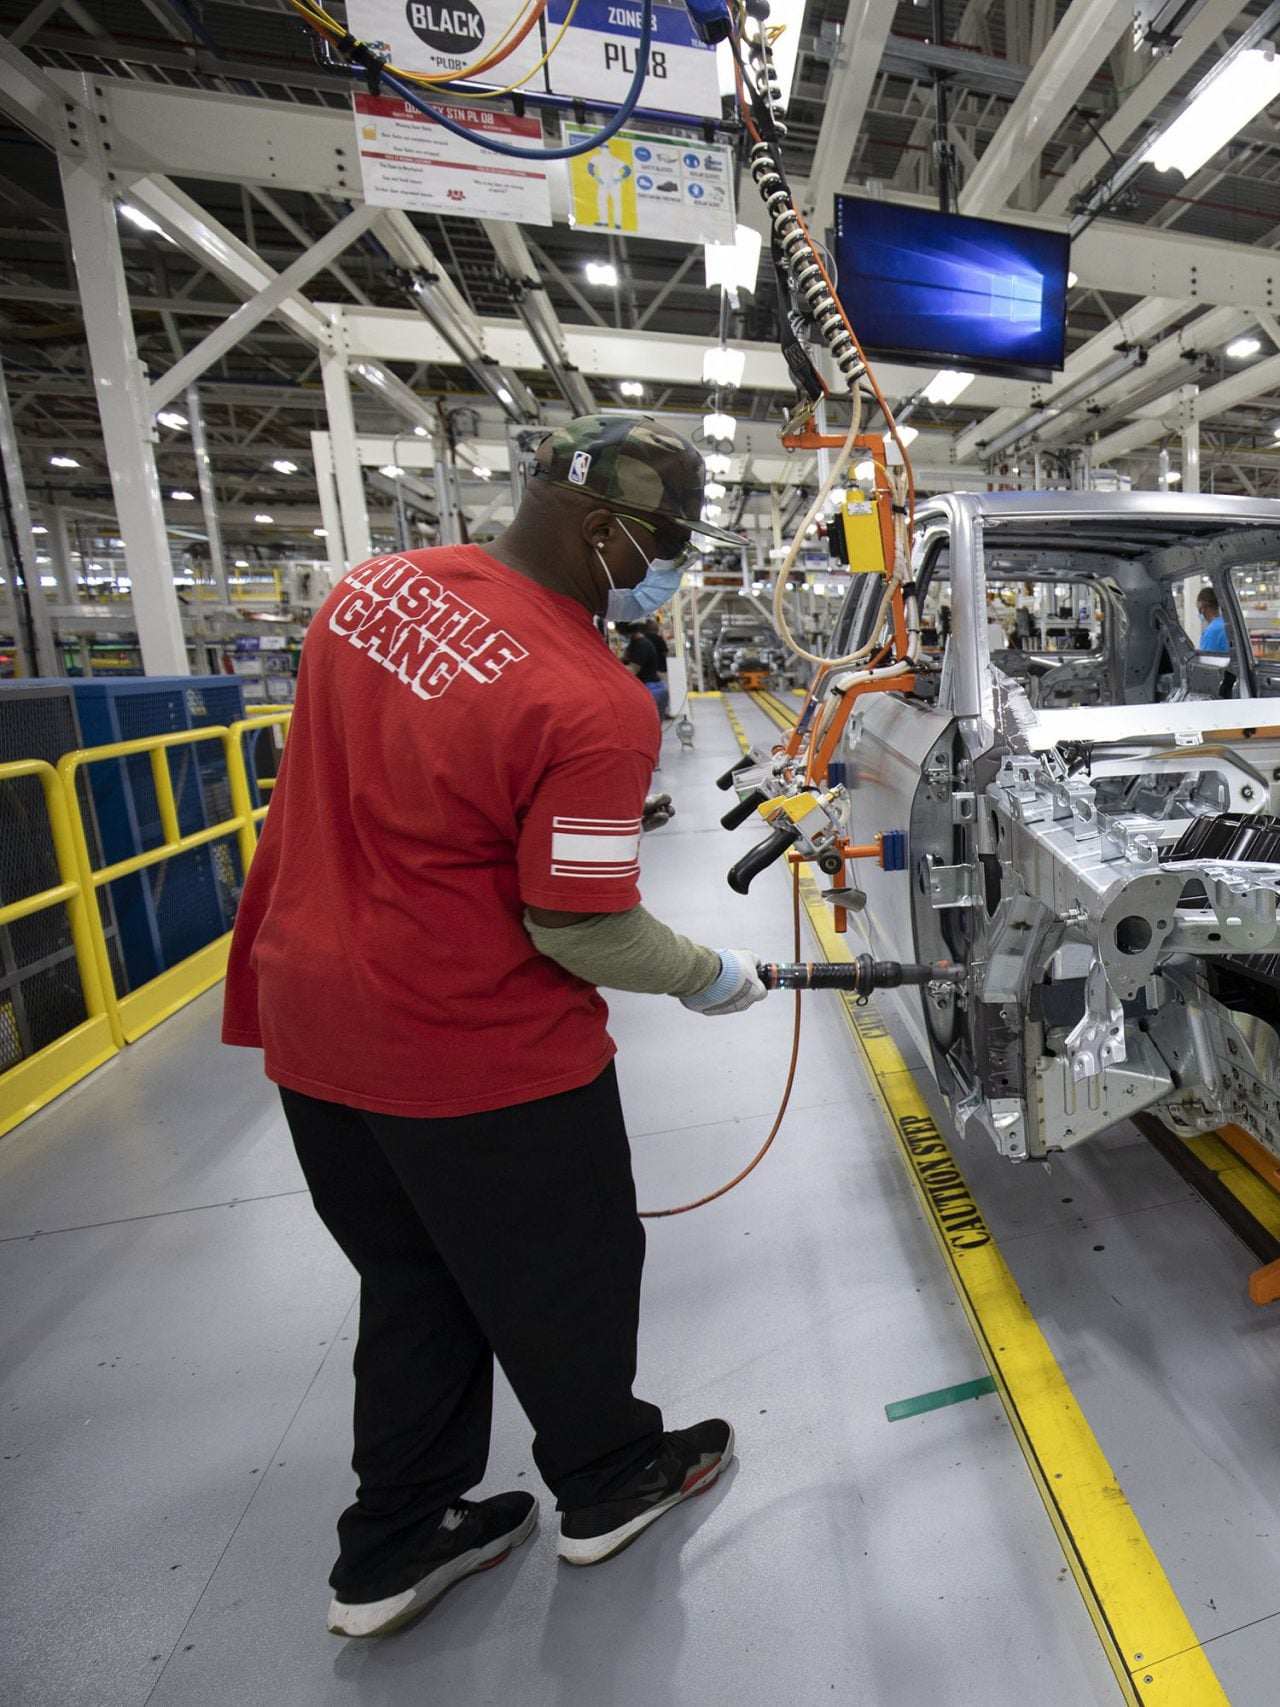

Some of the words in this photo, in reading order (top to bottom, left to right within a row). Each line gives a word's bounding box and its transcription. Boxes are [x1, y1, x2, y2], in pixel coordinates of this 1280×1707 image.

[410, 3, 483, 39] BLACK
[608, 7, 643, 29] ZONE
[604, 42, 667, 79] PL8
[446, 107, 466, 120] STN
[467, 110, 479, 123] PL
[344, 556, 529, 684] HUSTLE
[329, 589, 462, 700] GANG
[899, 1114, 949, 1157] STEP
[917, 1157, 991, 1250] CAUTION
